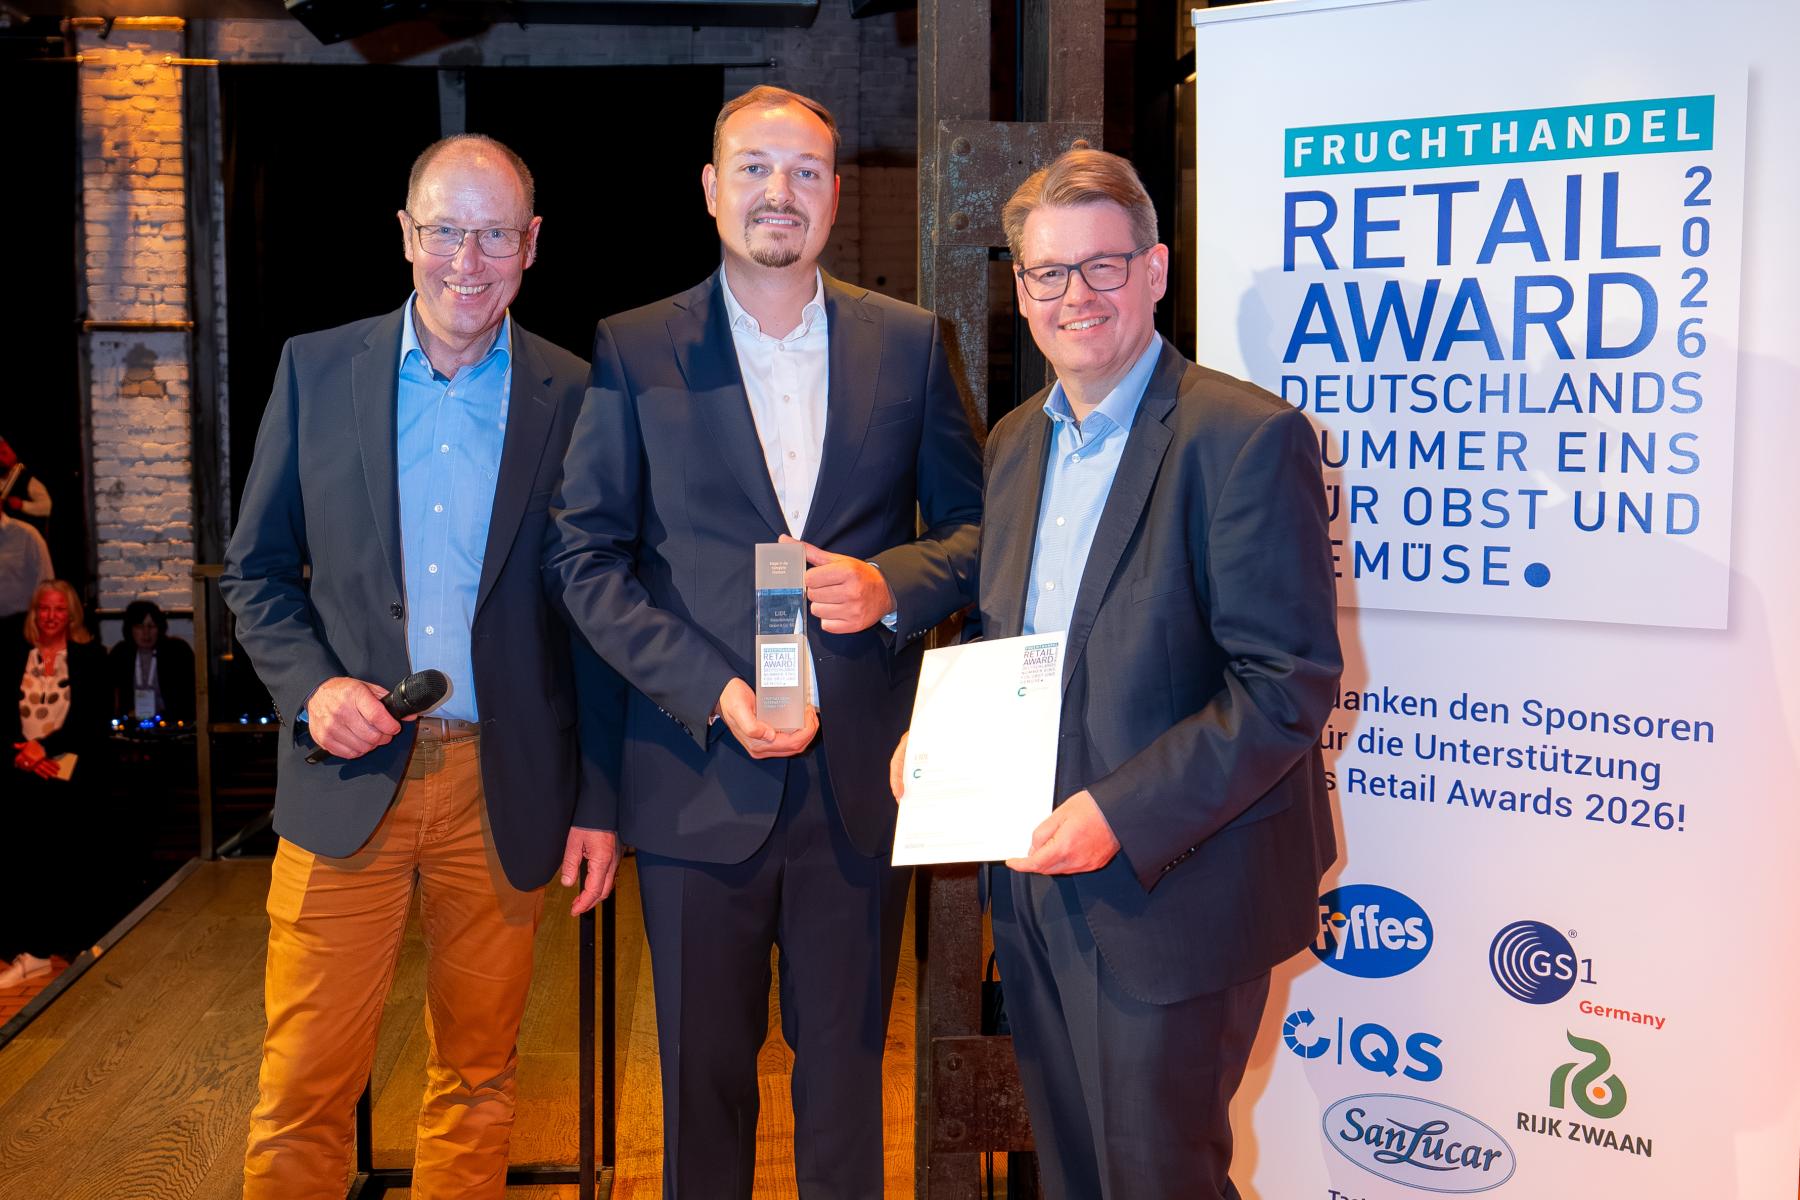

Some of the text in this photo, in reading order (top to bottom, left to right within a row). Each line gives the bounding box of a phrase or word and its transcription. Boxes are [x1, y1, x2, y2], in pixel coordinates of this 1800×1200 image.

[1293, 107, 1700, 168] FRUCHTHANDEL
[1282, 171, 1661, 272] RETAIL
[1677, 165, 1713, 359] 2026
[1282, 272, 1659, 364] AWARD
[1281, 371, 1703, 415] DEUTSCHLANDS
[1320, 430, 1701, 475] UMMER EINS
[1402, 487, 1548, 531] OBST
[1574, 491, 1701, 536] UND
[763, 653, 791, 661] RETAIL
[1024, 647, 1055, 658] RETAIL
[1024, 656, 1054, 665] AWARD
[1448, 692, 1511, 724] den
[1522, 699, 1715, 744] Sponsoren
[1321, 724, 1662, 791] ür die Unterstützung
[1347, 768, 1436, 803] Retail
[1447, 779, 1574, 818] Awards
[1584, 793, 1687, 833] 2026!
[1317, 904, 1428, 960] Fyffes
[1579, 999, 1666, 1031] Germany
[1349, 1022, 1443, 1083] QS
[1339, 1106, 1502, 1173] SanLucar
[1516, 1111, 1653, 1158] RIJK ZWAAN
